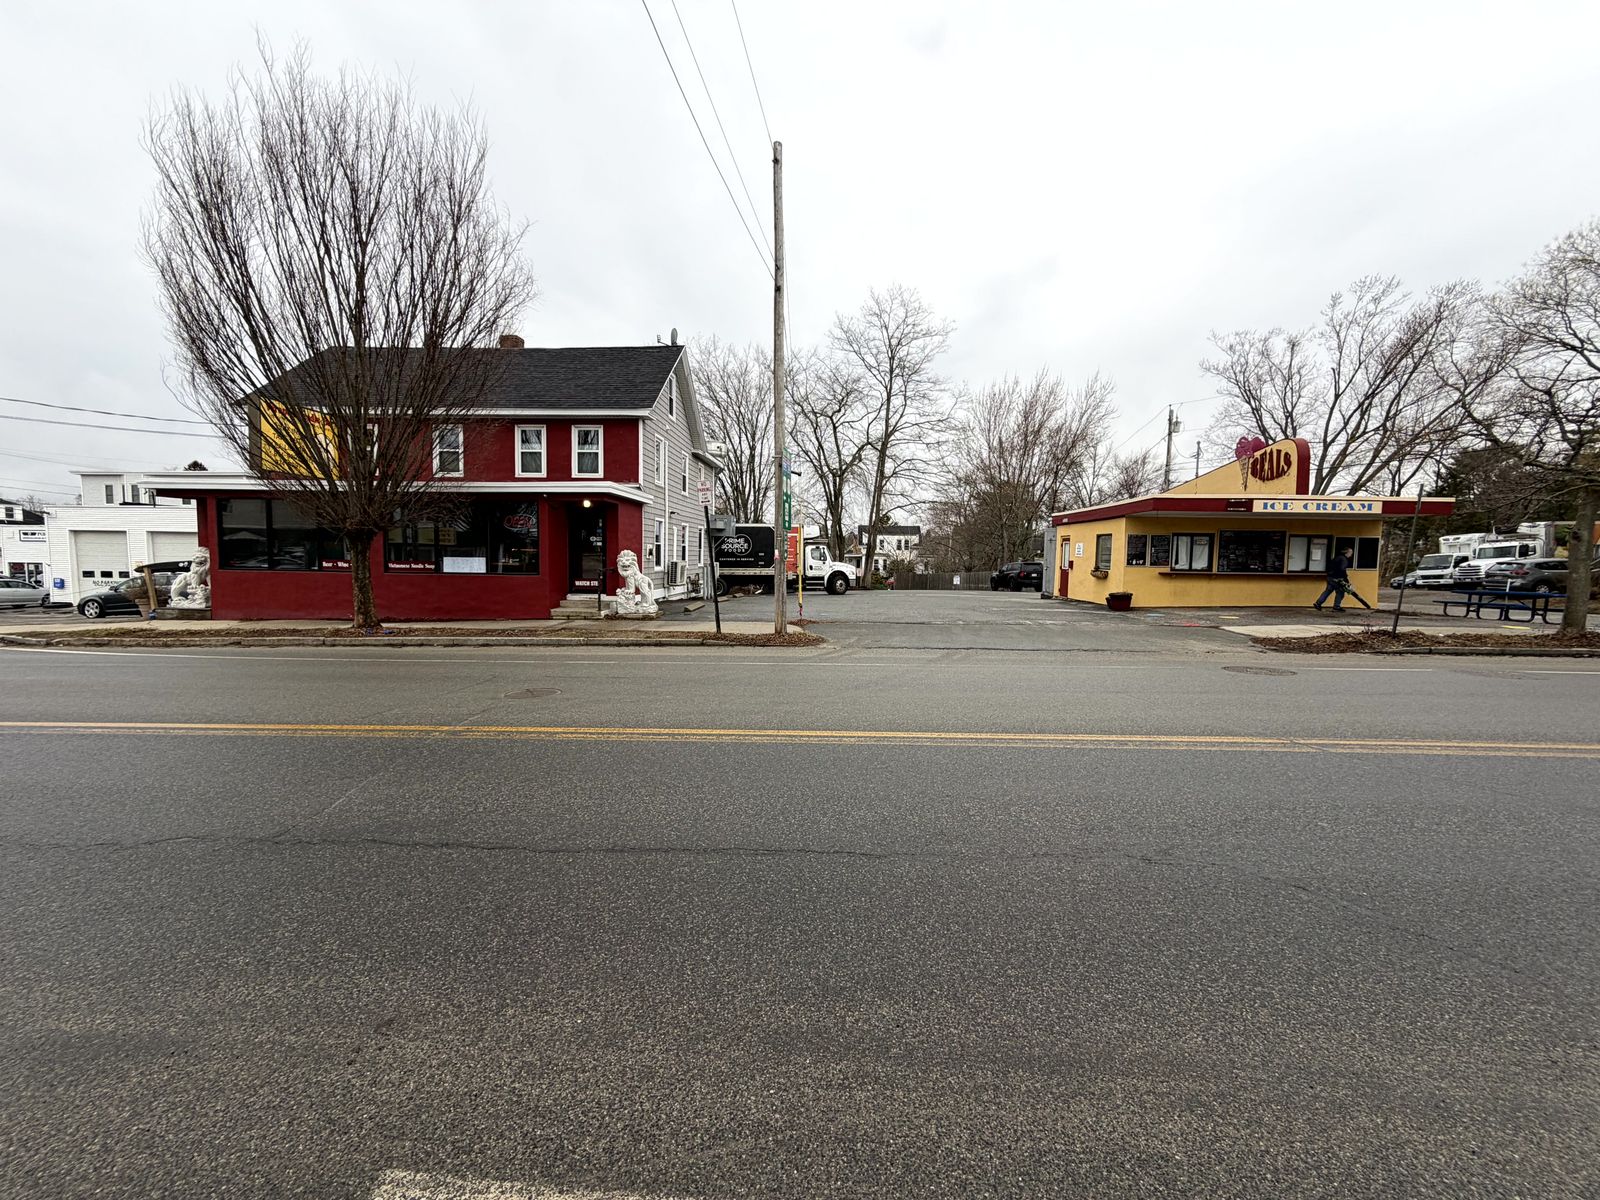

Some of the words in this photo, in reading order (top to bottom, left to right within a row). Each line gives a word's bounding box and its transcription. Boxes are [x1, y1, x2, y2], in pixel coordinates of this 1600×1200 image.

[1250, 448, 1292, 482] BEALS
[1263, 502, 1294, 511] ICE
[1303, 502, 1373, 512] CREAM
